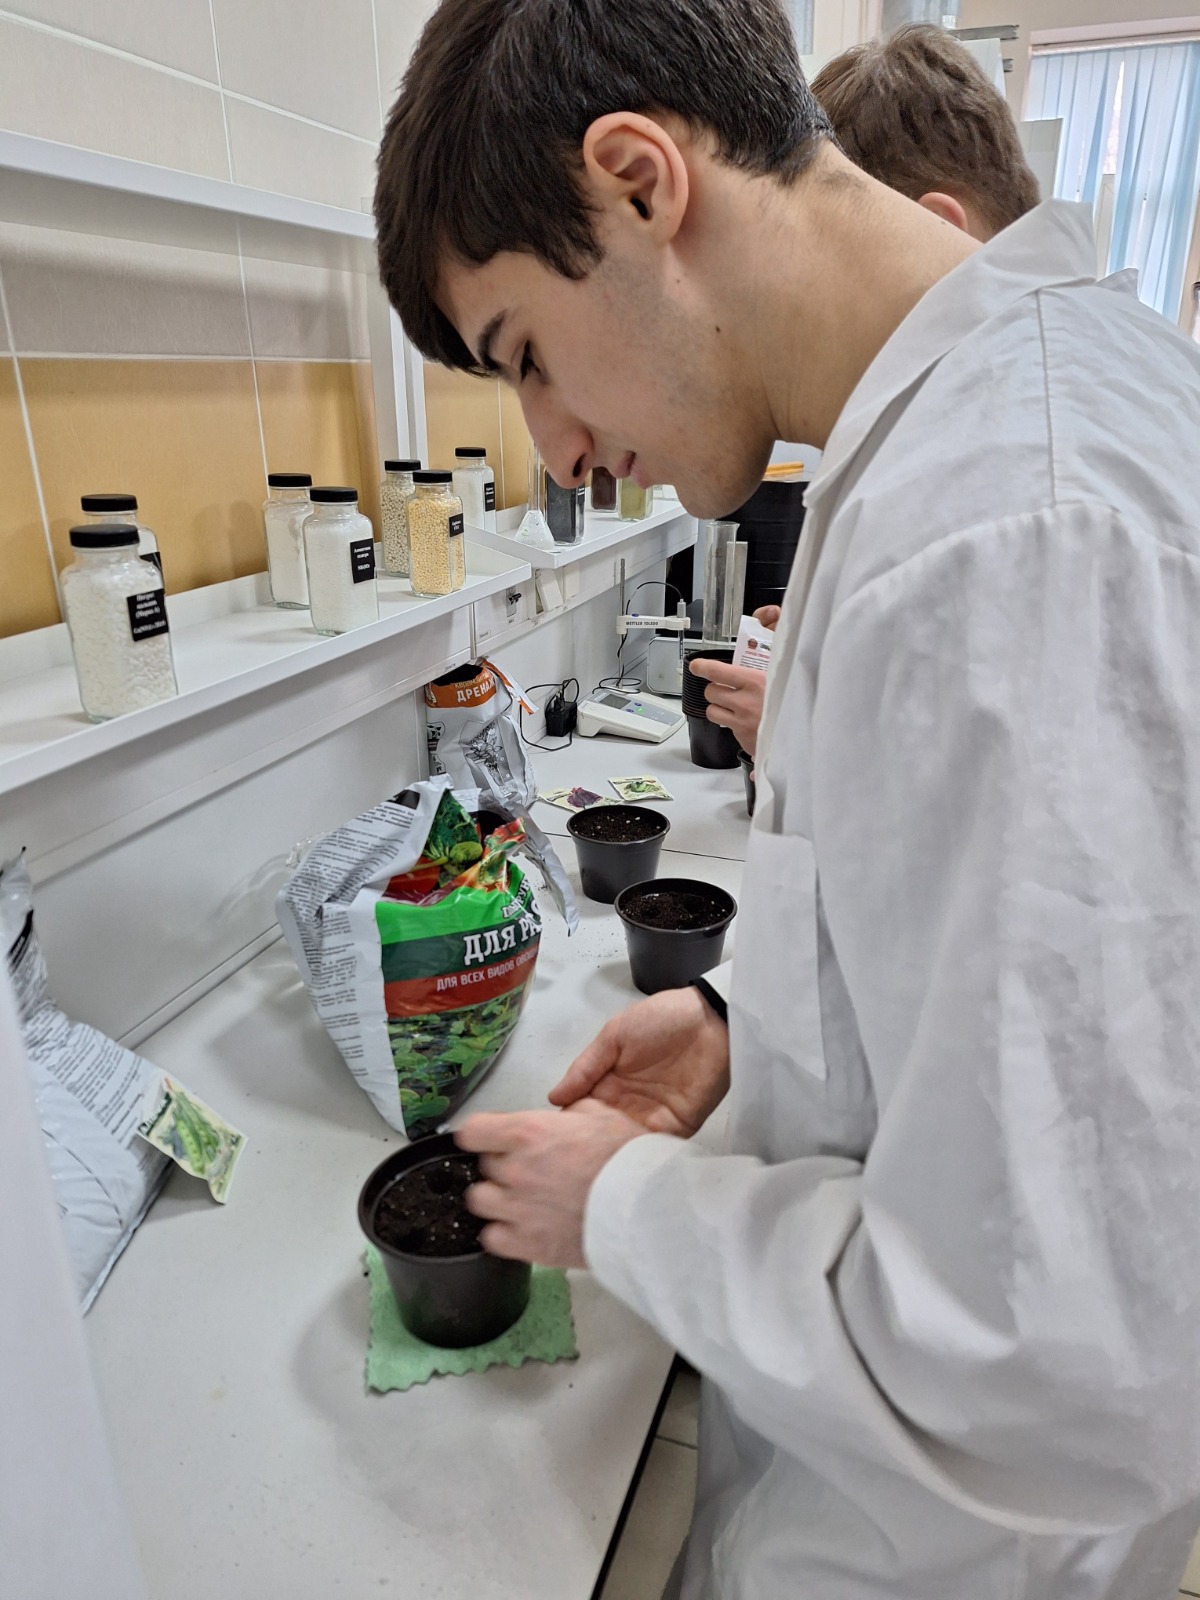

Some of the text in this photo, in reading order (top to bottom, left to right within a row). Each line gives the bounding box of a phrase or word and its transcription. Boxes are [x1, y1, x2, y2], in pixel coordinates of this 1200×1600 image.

[456, 678, 496, 703] ДРЕНАЖ
[463, 924, 517, 966] ДЛЯ
[436, 975, 458, 992] ДЛЯ
[460, 970, 486, 986] ВСЕХ
[487, 959, 515, 979] ВИДОВ
